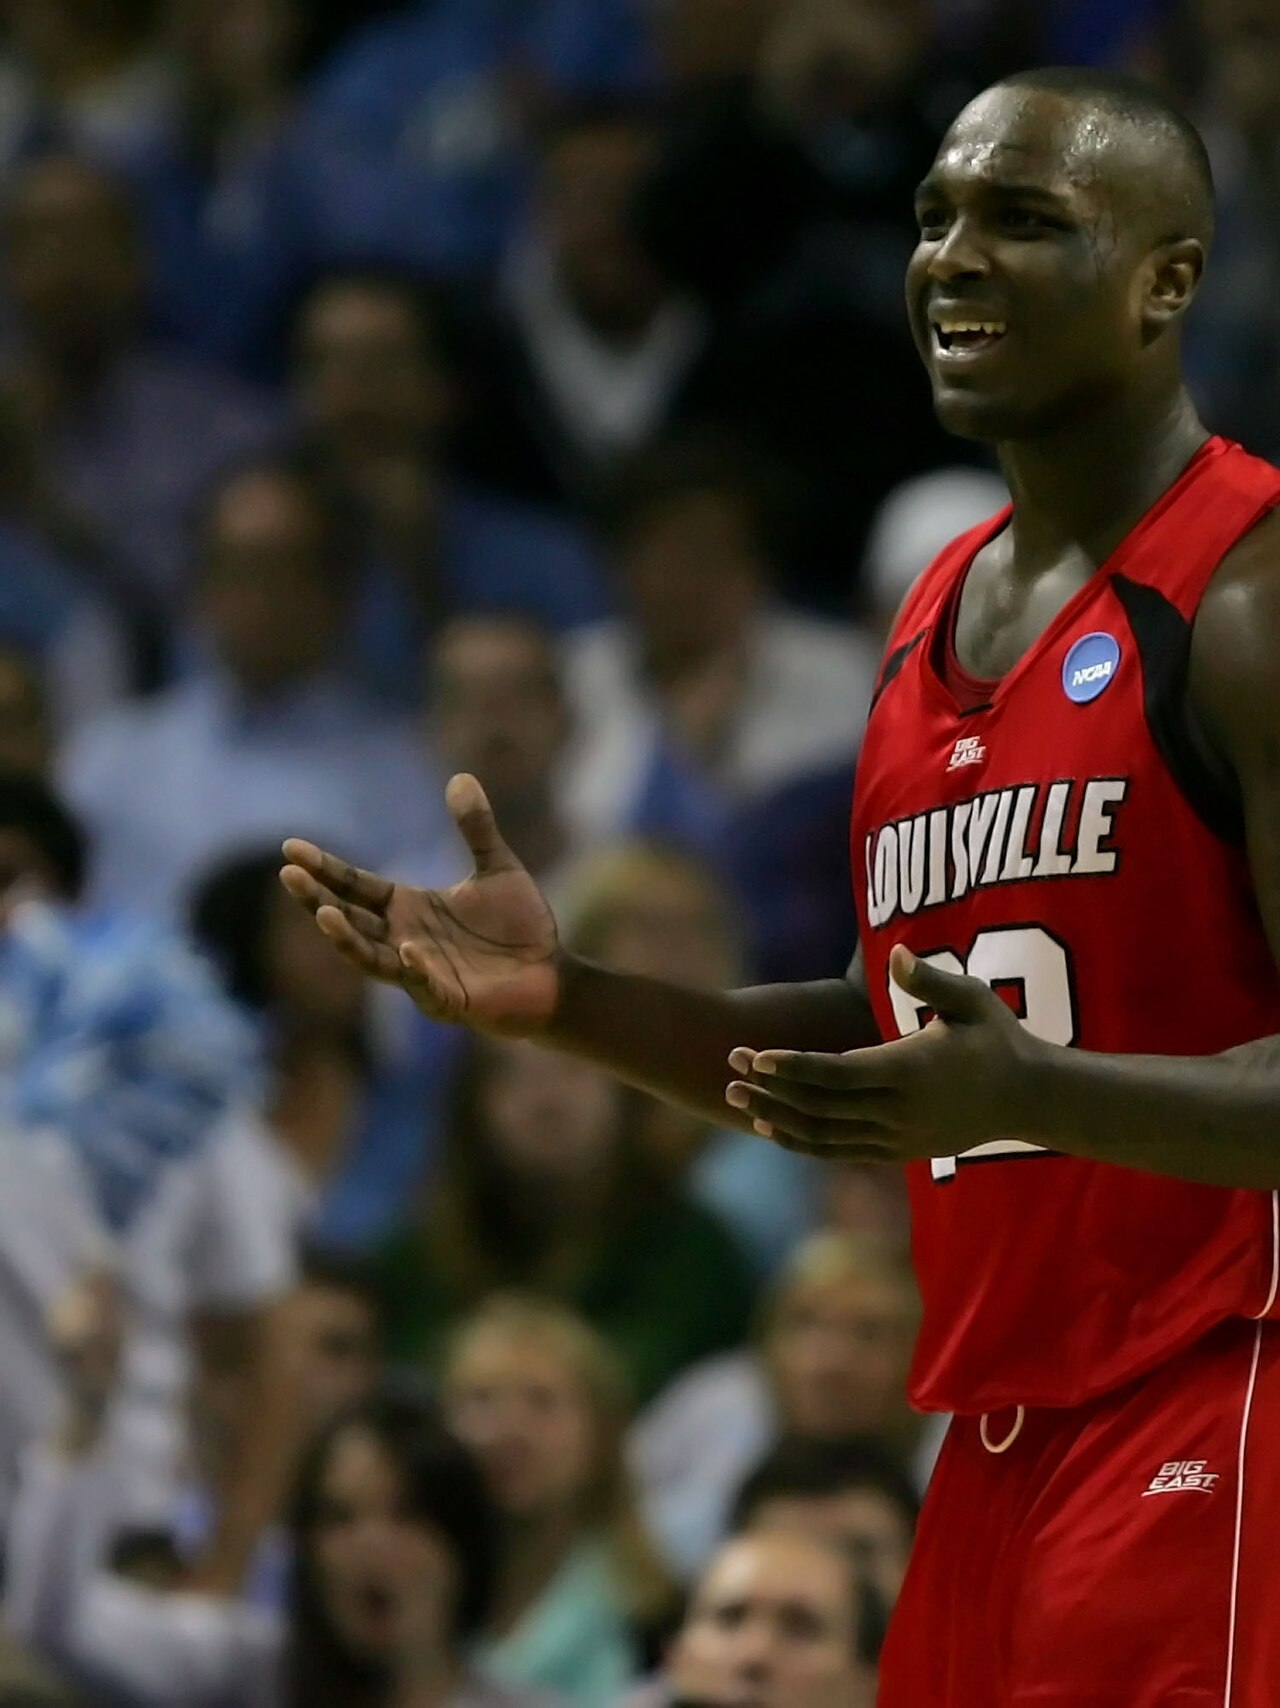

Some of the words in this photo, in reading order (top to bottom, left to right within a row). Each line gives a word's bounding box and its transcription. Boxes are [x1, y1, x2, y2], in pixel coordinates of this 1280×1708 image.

[1072, 660, 1112, 687] NCAA
[865, 778, 1128, 930] LOUISVILLE
[1157, 1460, 1208, 1477] BIG
[1148, 1473, 1220, 1490] EAST
